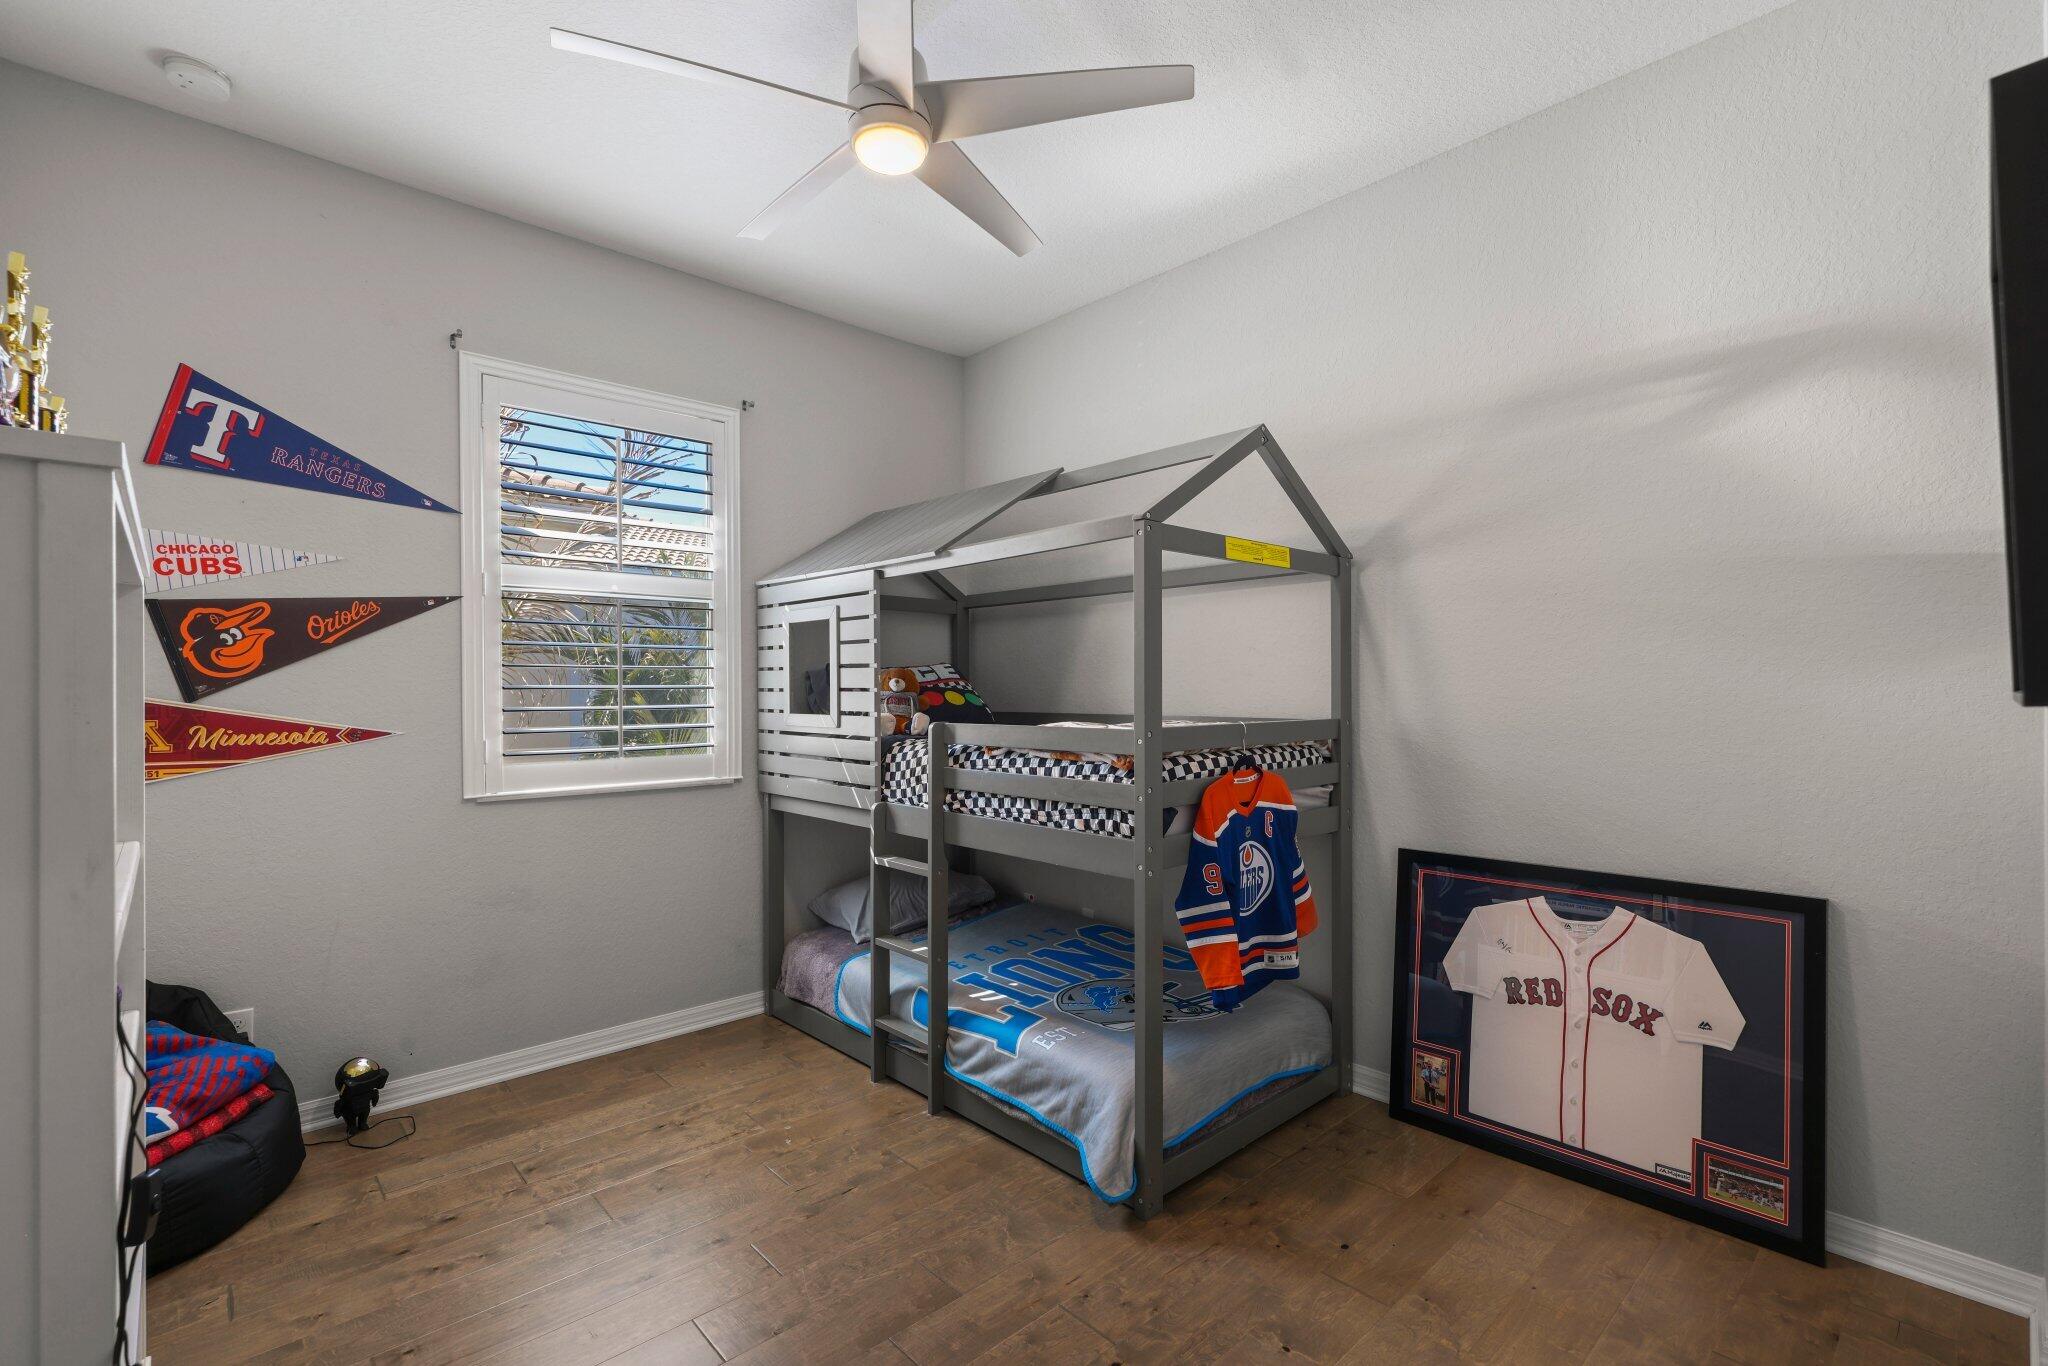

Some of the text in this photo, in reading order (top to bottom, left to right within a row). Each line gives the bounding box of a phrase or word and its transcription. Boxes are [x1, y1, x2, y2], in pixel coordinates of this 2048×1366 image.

[185, 388, 265, 470] T
[309, 446, 361, 472] TEXAS
[271, 446, 386, 498] RANGERS
[156, 543, 235, 555] CHICAGO
[152, 556, 243, 577] CUBS
[307, 600, 380, 642] Orioles
[188, 725, 329, 750] Minnesota
[145, 770, 160, 778] 51
[1503, 976, 1664, 1037] RED SOX
[1032, 1026, 1086, 1050] EST.
